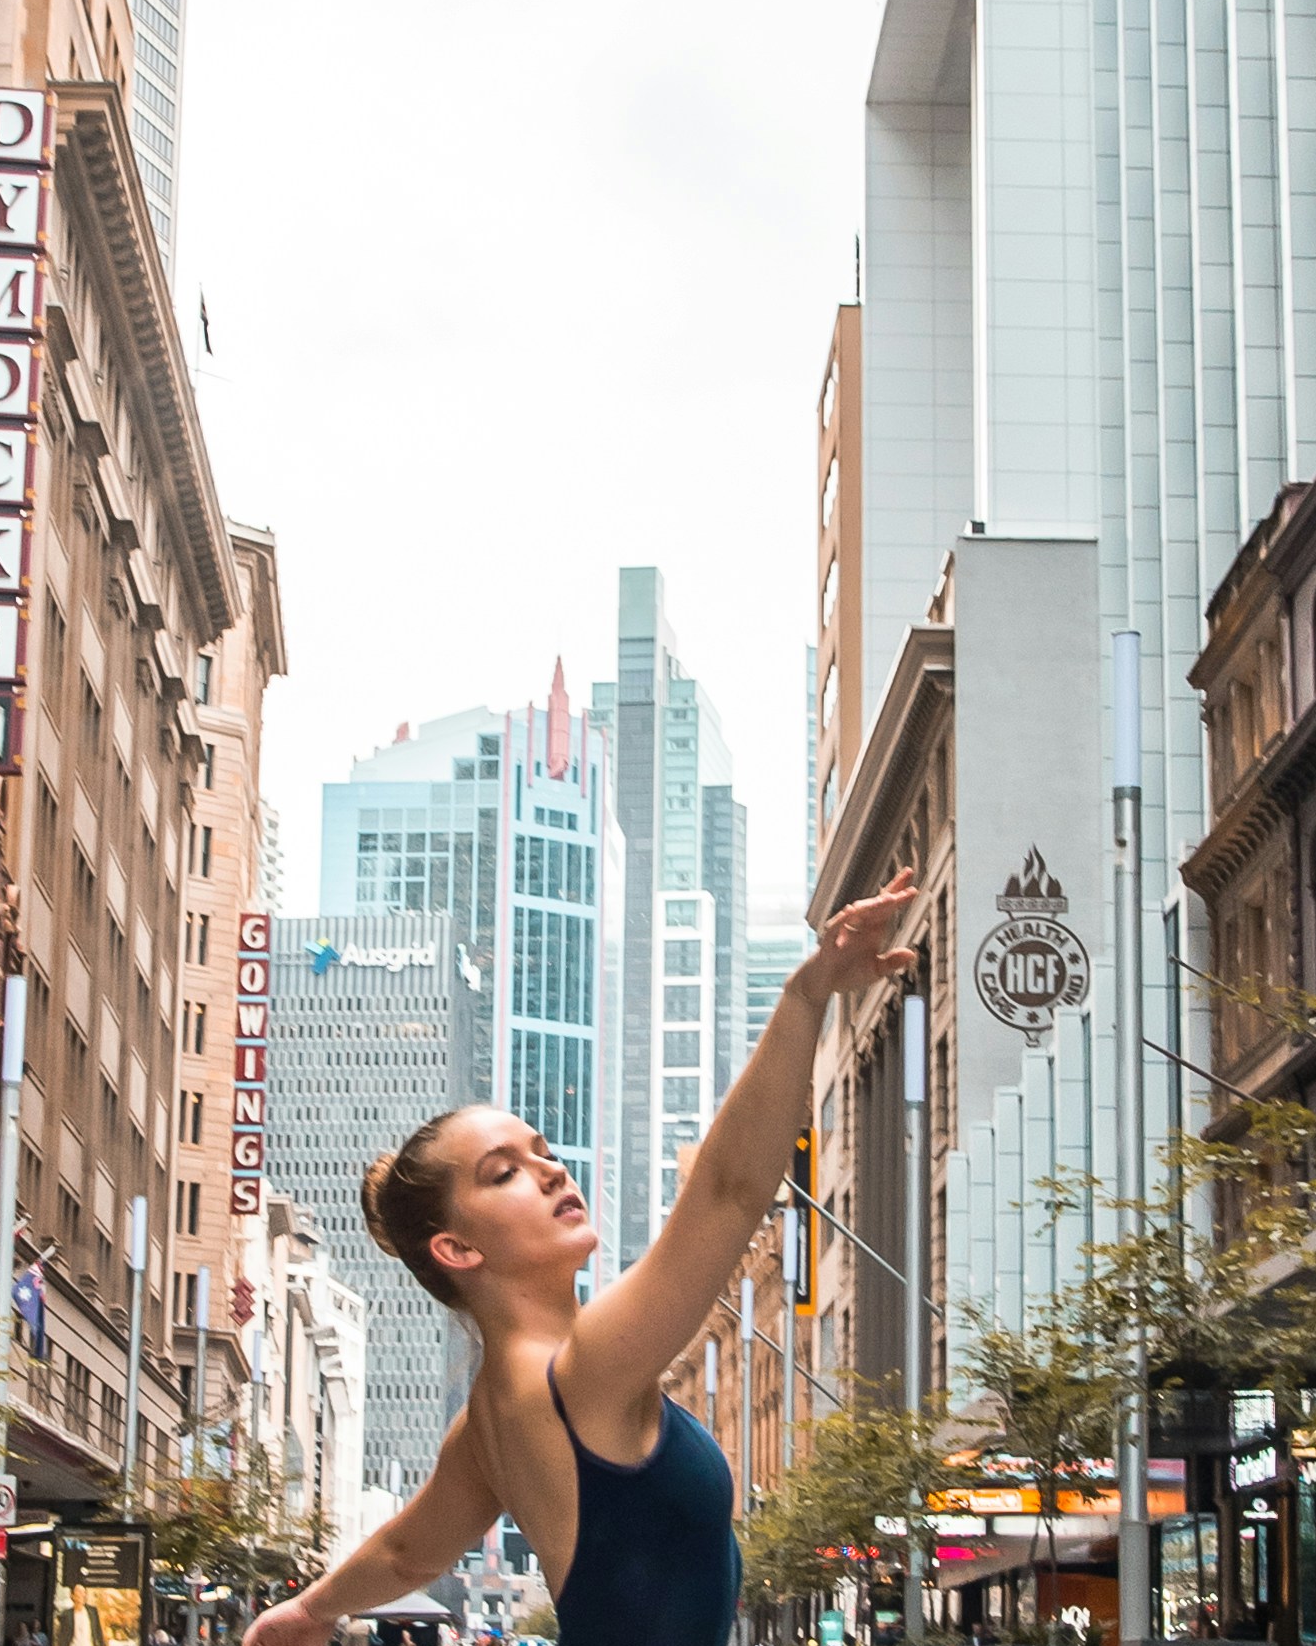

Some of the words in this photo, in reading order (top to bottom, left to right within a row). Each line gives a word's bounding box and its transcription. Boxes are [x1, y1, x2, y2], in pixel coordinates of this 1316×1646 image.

[995, 922, 1070, 949] HEALTH
[340, 941, 435, 972] Ausgrid
[1006, 953, 1061, 994] HCF
[981, 971, 1019, 1021] CARE
[233, 917, 268, 1212] GOWINGS
